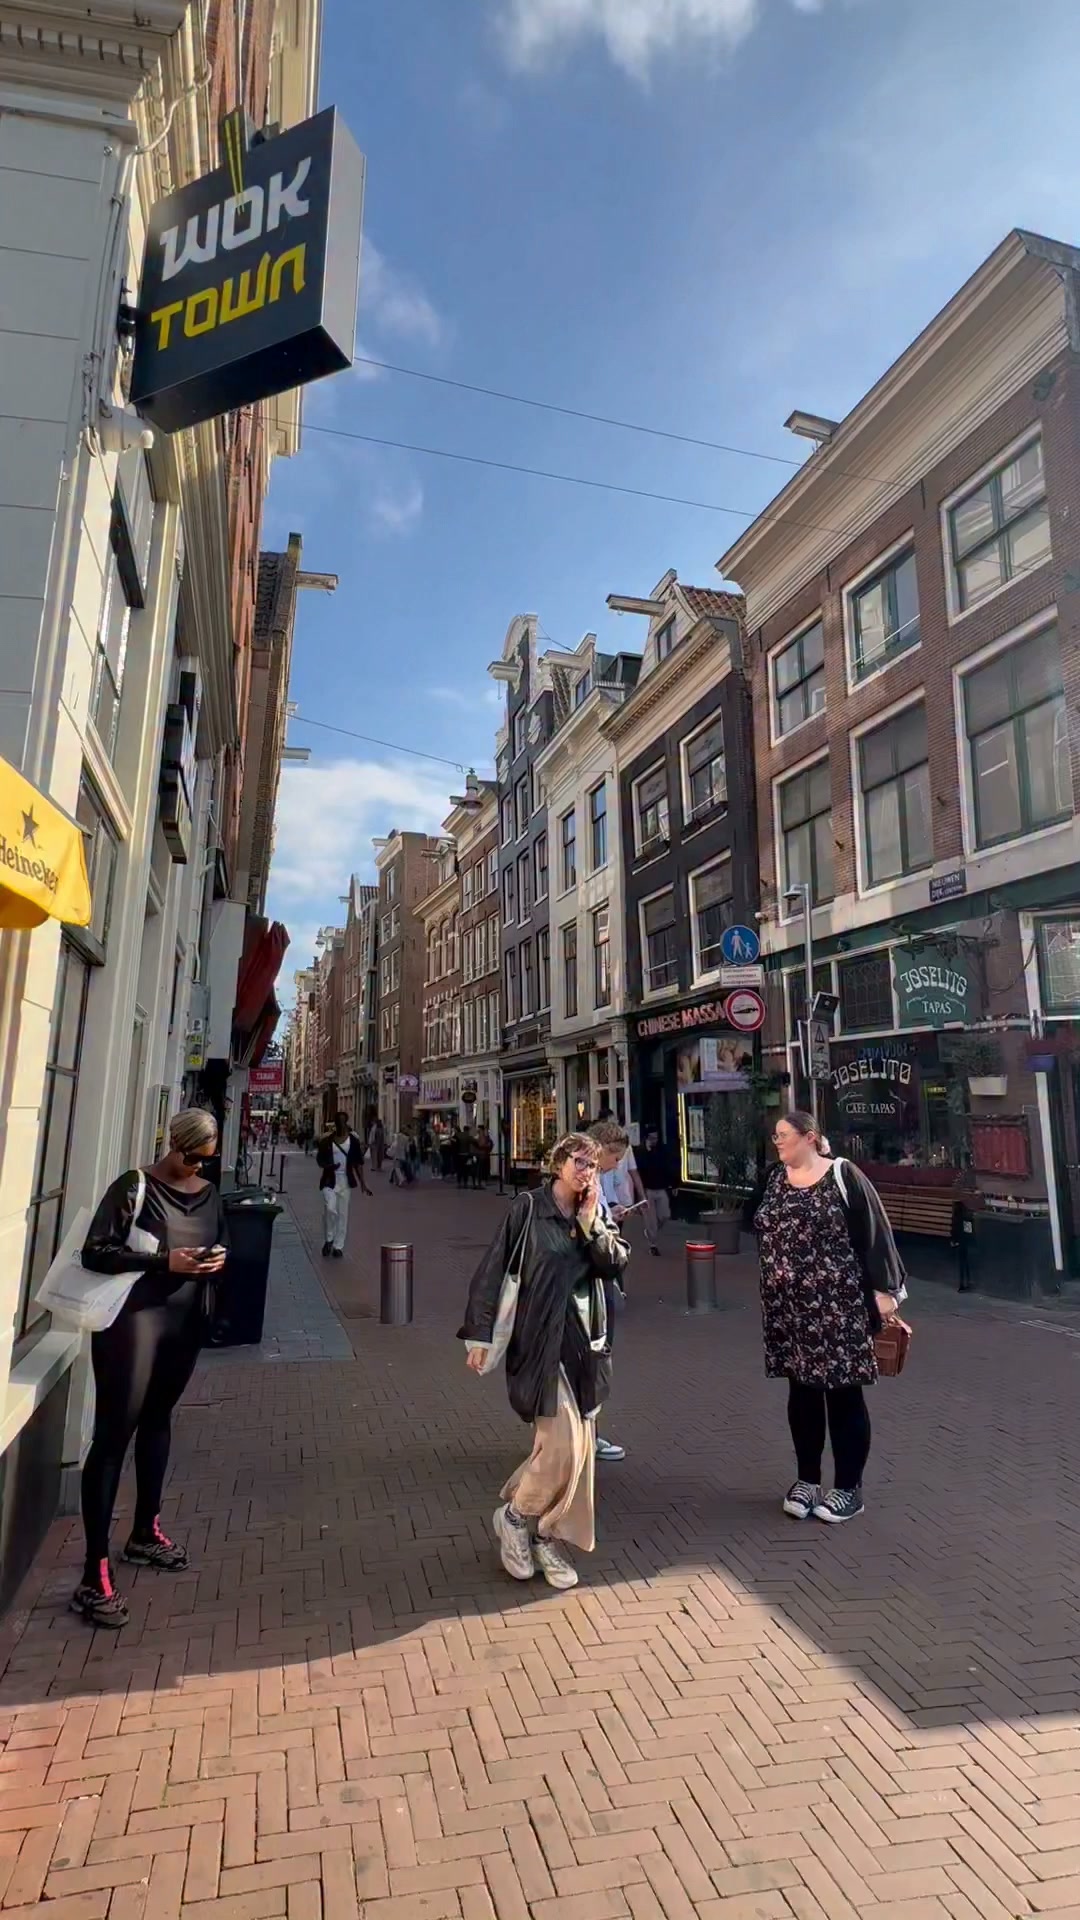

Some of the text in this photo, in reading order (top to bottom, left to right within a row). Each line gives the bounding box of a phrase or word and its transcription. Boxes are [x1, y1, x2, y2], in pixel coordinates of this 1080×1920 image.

[160, 156, 312, 282] WOK
[151, 242, 306, 351] TOWN
[637, 1000, 726, 1037] CHINESE MASSA
[922, 1000, 952, 1014] TAPAS
[830, 1058, 911, 1090] JOSELITO
[870, 1103, 896, 1115] TAPAS
